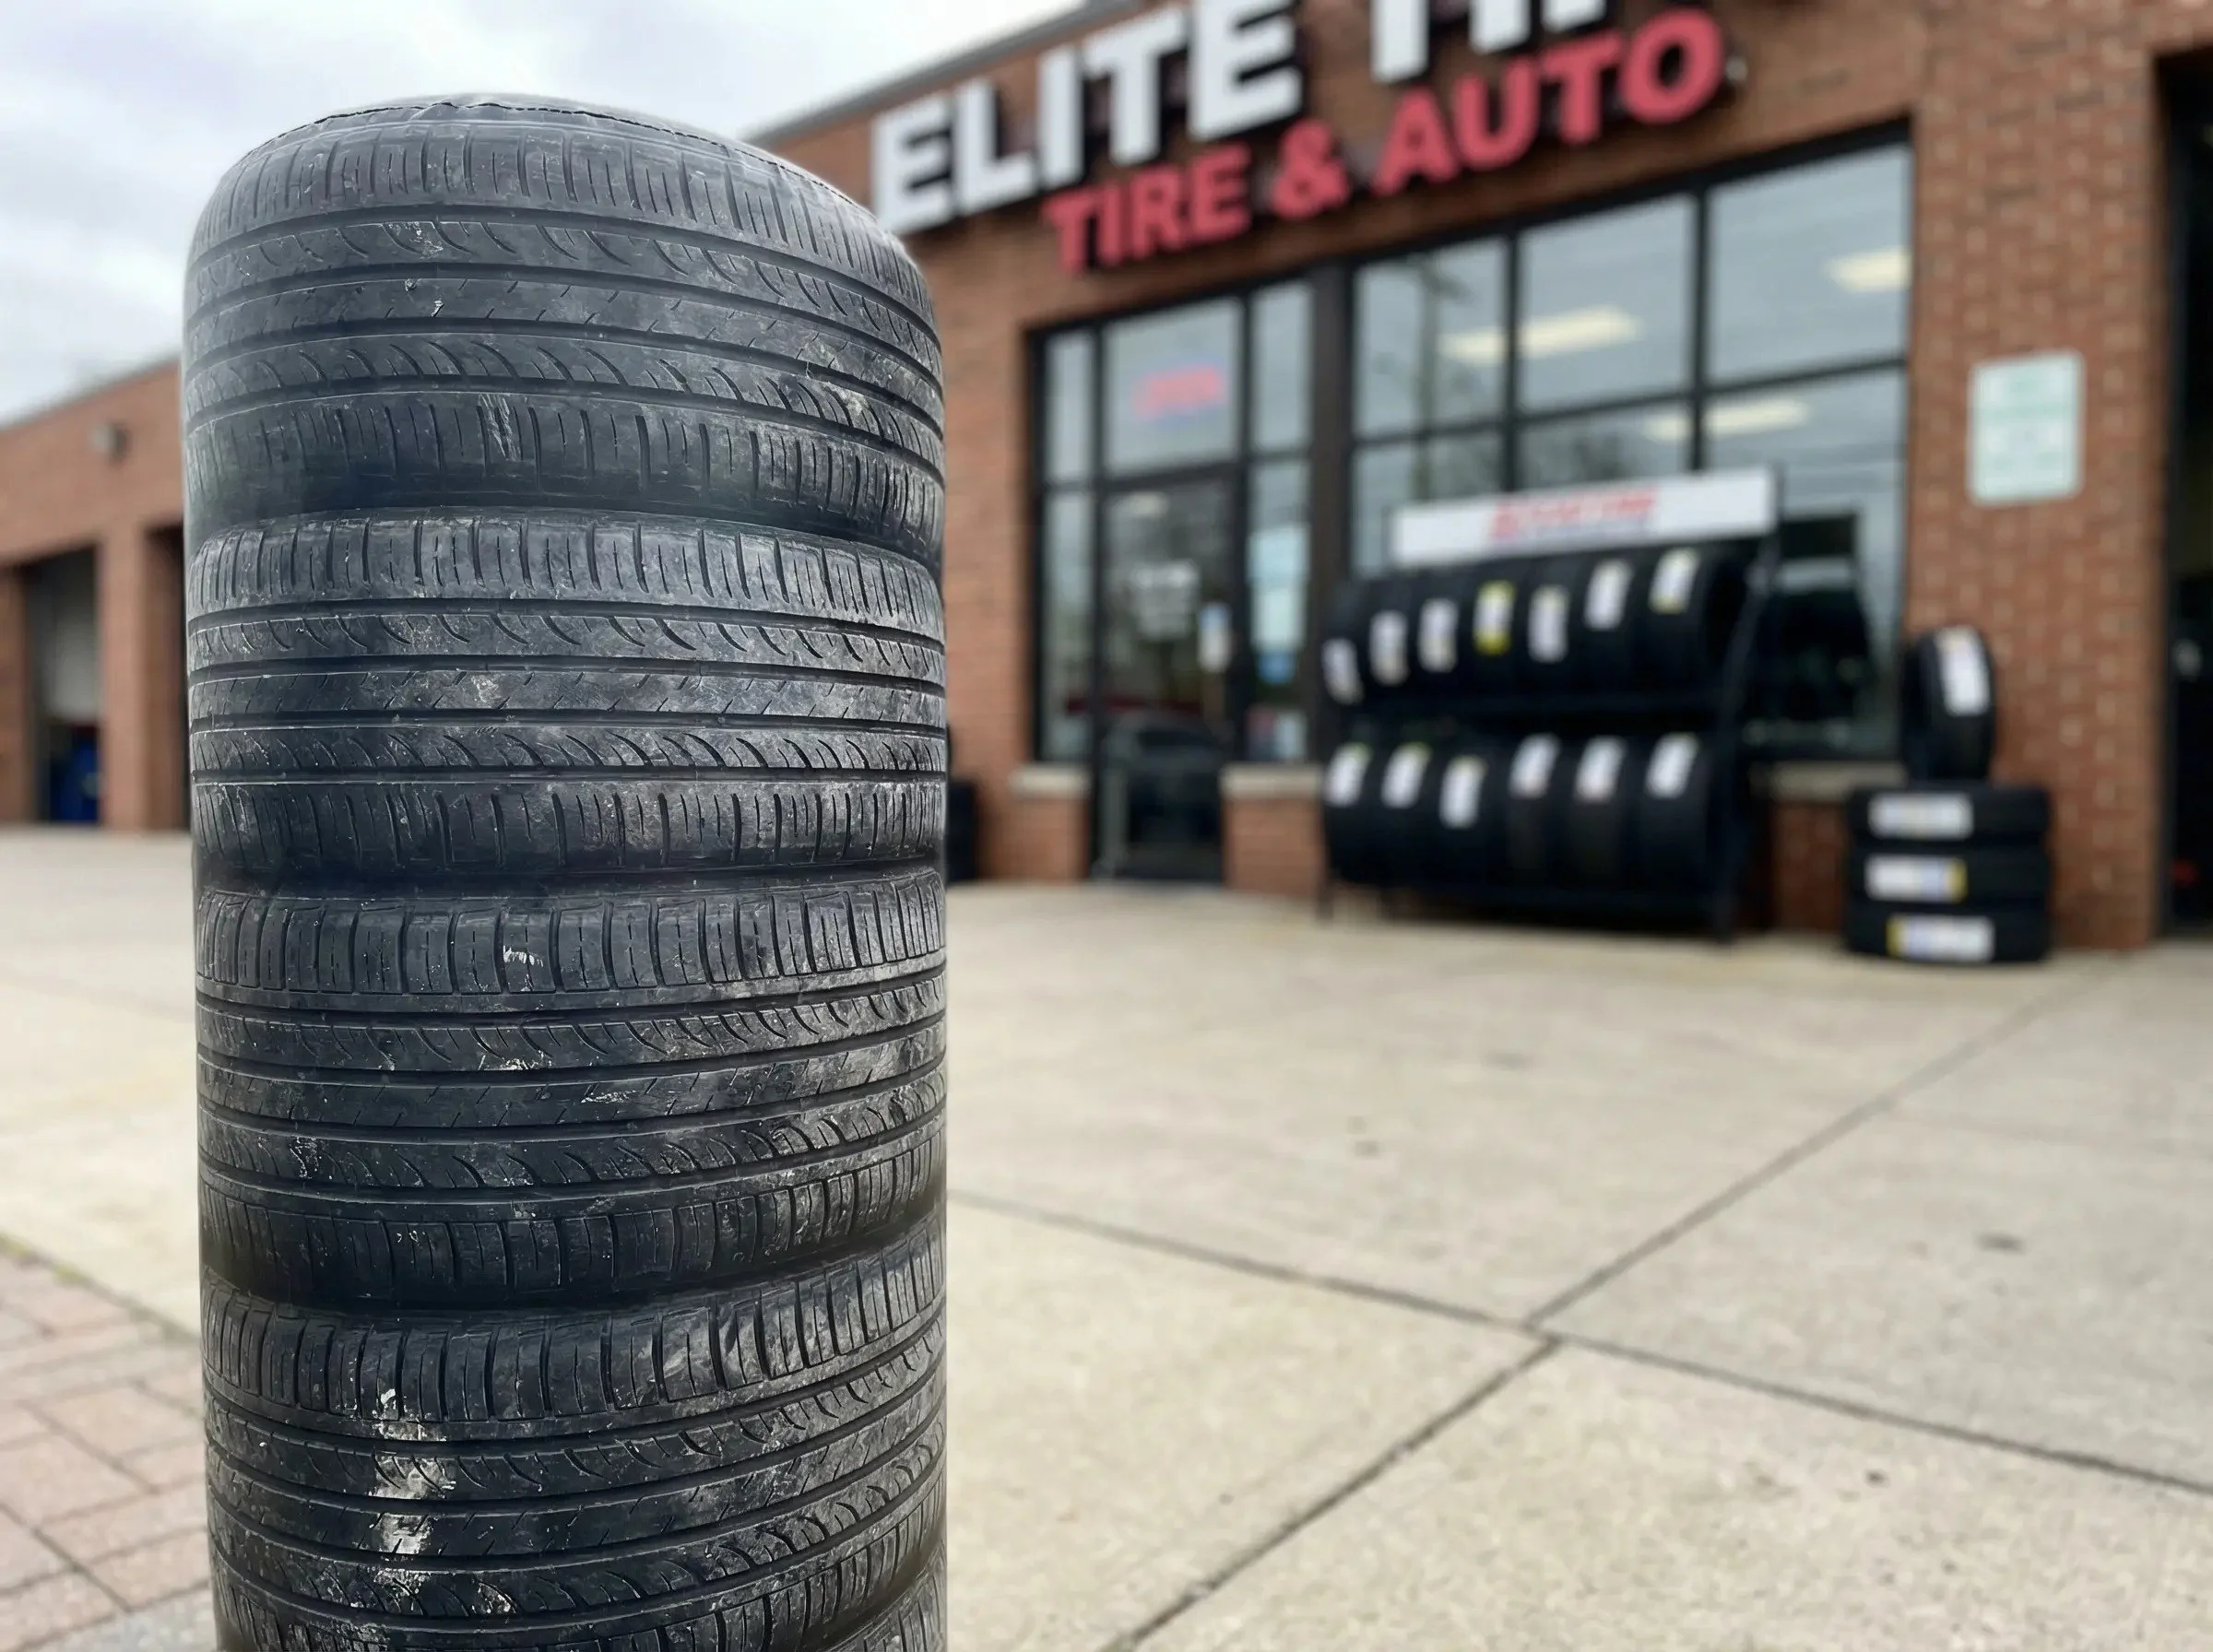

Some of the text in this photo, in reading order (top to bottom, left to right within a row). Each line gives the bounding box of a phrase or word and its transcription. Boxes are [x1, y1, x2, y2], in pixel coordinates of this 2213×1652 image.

[872, 0, 1303, 232] ELITE
[1043, 146, 1251, 273] TIRE
[1272, 120, 1349, 219] &
[1374, 8, 1722, 194] AUTO
